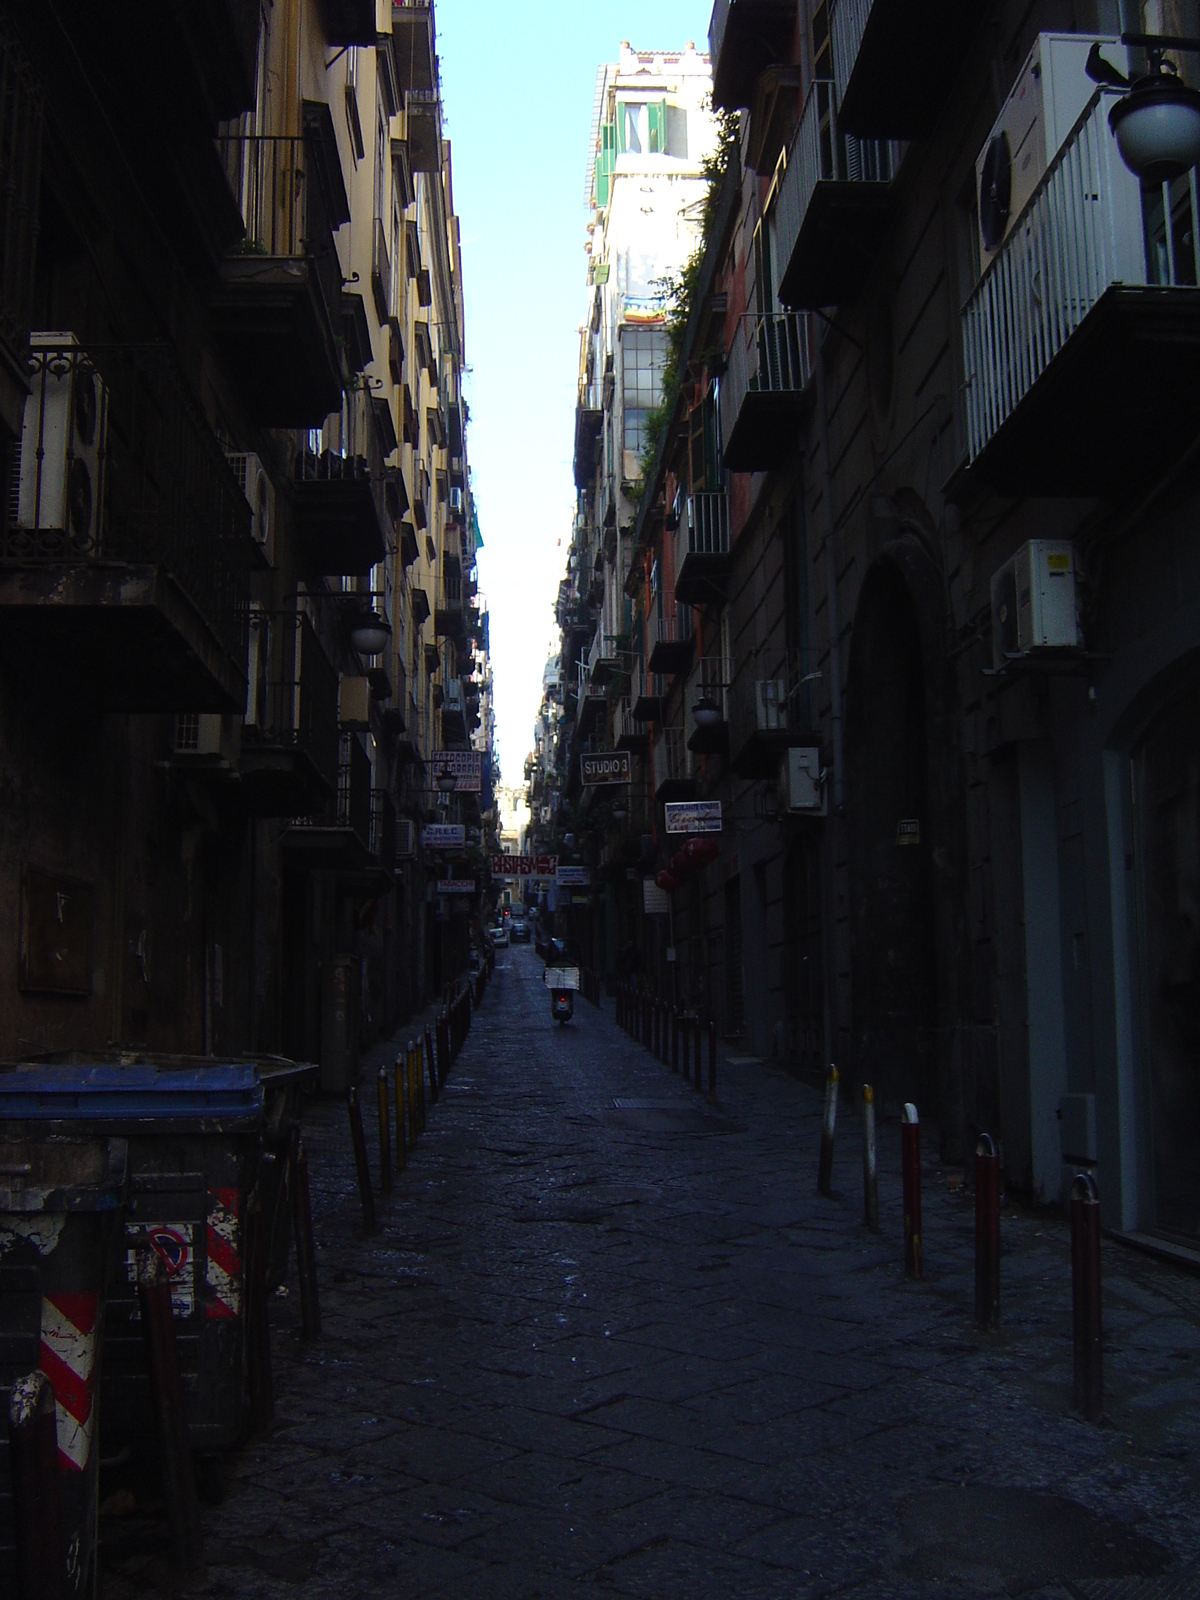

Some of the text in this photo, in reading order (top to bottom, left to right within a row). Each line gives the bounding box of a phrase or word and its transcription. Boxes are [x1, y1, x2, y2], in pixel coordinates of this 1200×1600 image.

[433, 753, 480, 763] FOTOCOPIE
[584, 759, 628, 774] STUDIO 3
[667, 803, 699, 811] RISTORANTE
